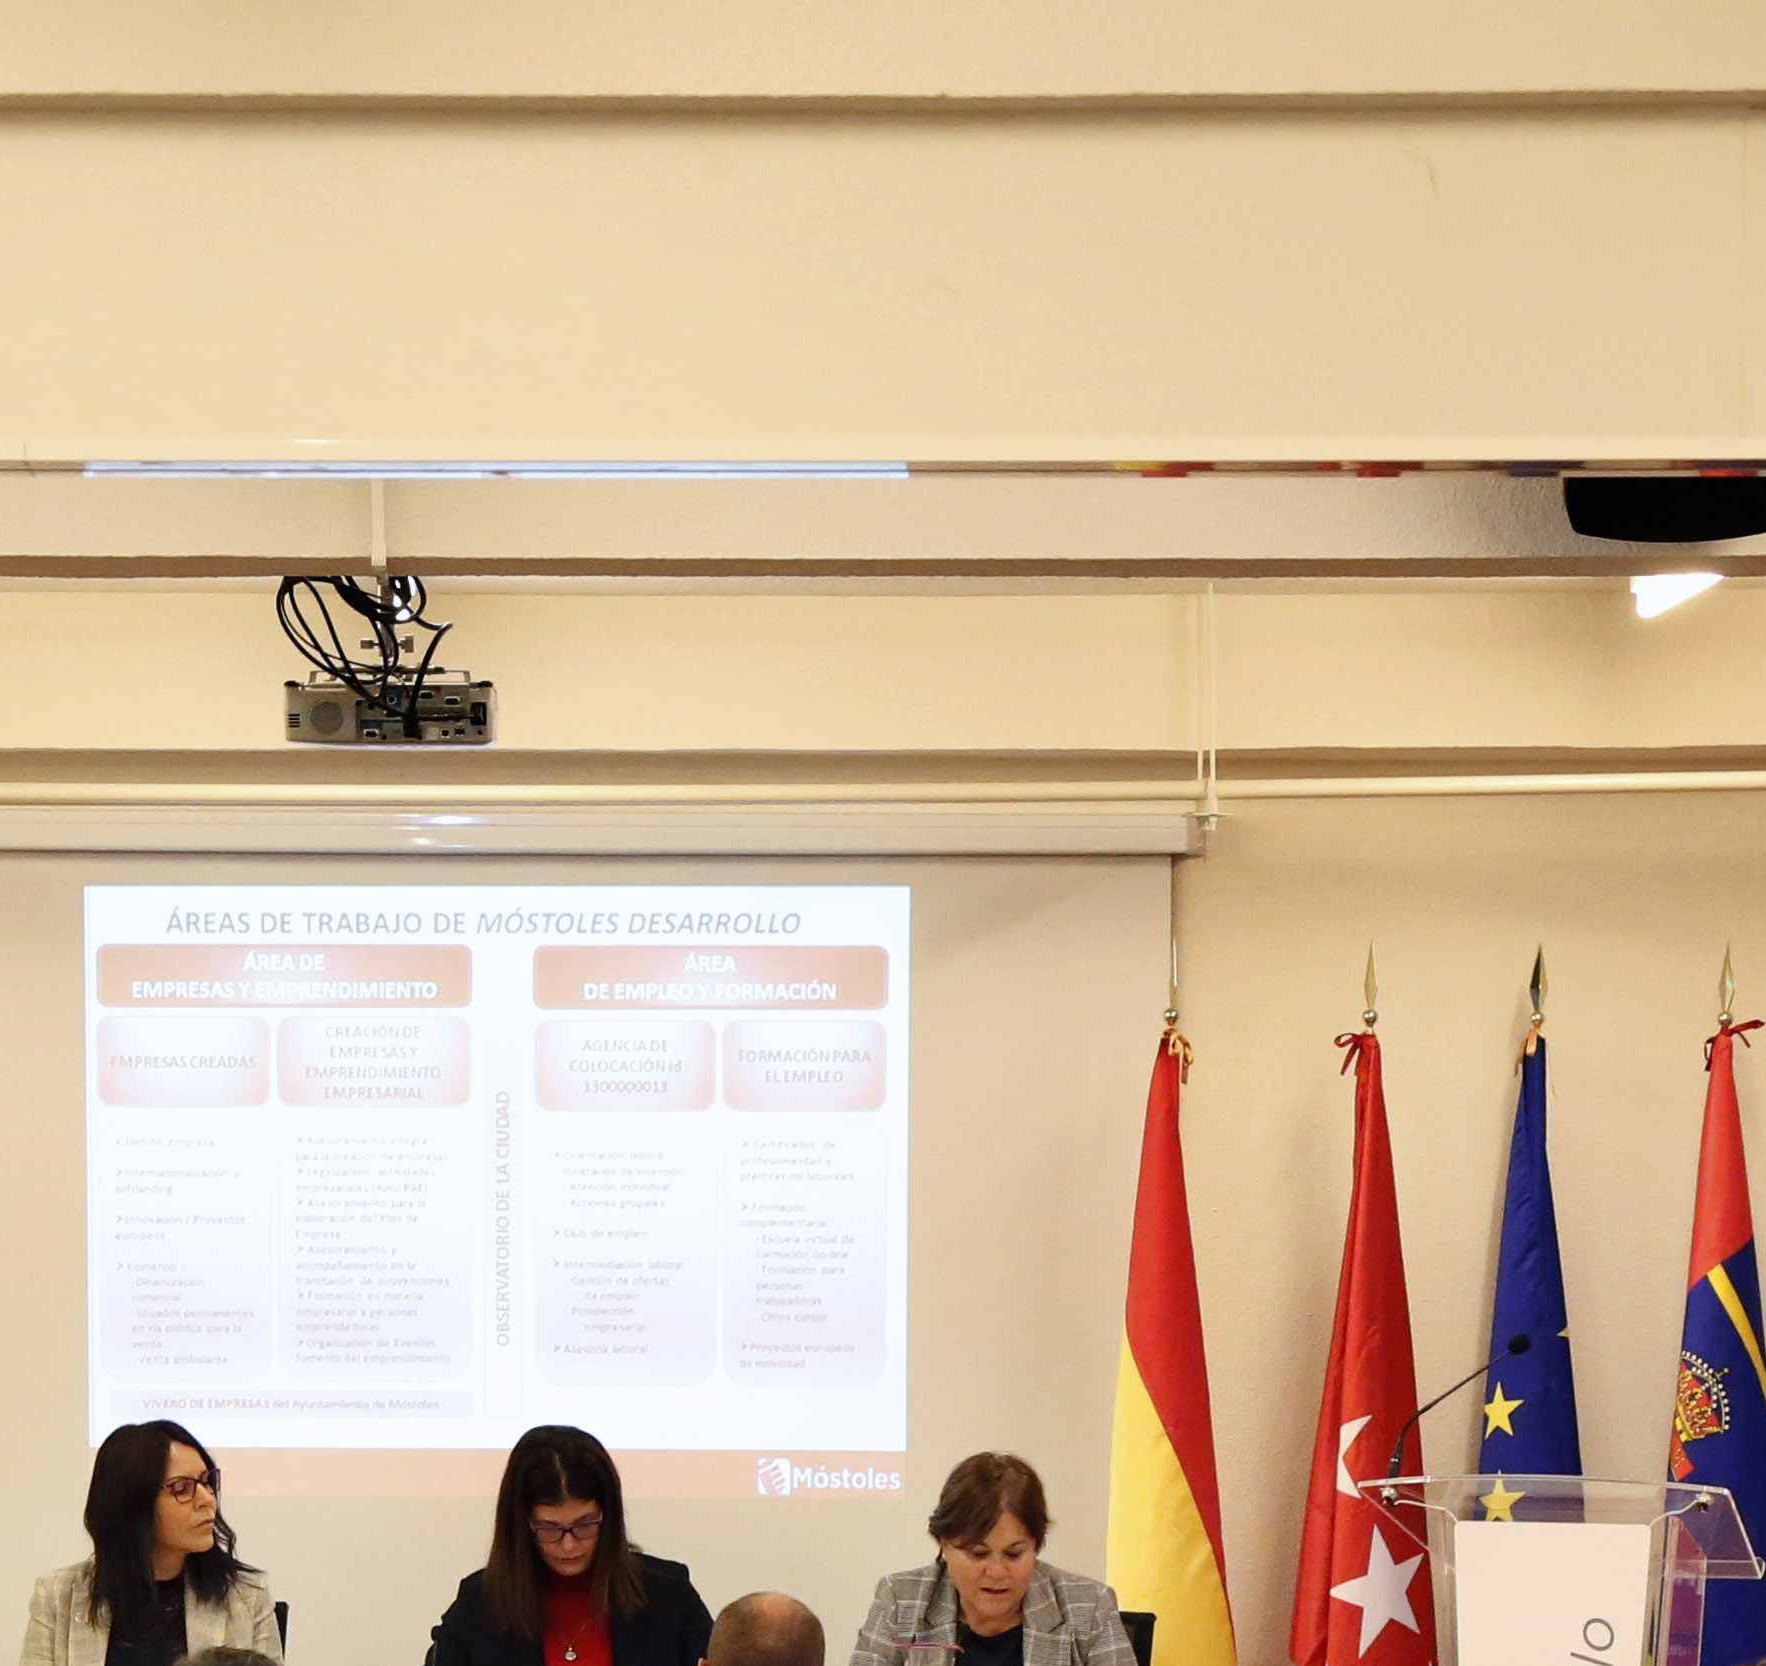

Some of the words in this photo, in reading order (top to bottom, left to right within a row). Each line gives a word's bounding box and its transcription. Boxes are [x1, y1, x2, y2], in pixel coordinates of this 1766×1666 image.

[166, 907, 251, 934] ÁREAS
[261, 913, 292, 934] DE
[303, 913, 422, 934] TRABAJO
[434, 913, 466, 934] DE
[477, 907, 619, 934] MÓSTOLES
[628, 913, 801, 934] DESARROLLO
[243, 951, 294, 972] ÁREA
[298, 955, 325, 972] DE
[684, 953, 736, 973] ÁREA
[132, 982, 235, 1000] EMPRESAS
[238, 982, 252, 1000] Y
[255, 981, 438, 1000] EMPRENDIMIENTO
[583, 983, 609, 1000] DE
[614, 983, 694, 1000] EMPLEO
[698, 983, 712, 1000] Y
[716, 980, 836, 1000] FORMACIÓN
[325, 1024, 400, 1038] CREACIÓN
[402, 1026, 420, 1038] DE
[329, 1046, 408, 1058] EMPRESAS
[409, 1046, 417, 1058] Y
[582, 1040, 647, 1052] AGENCIA
[650, 1040, 668, 1052] DE
[110, 1056, 188, 1069] EMPRESAS
[190, 1056, 256, 1069] CREADAS
[738, 1048, 830, 1063] FORMACIÓN
[833, 1050, 871, 1063] PARA
[305, 1066, 441, 1079] EMPRENDIMIENTO
[569, 1057, 665, 1073] COLOCACIÓN
[765, 1070, 780, 1083] EL
[784, 1070, 843, 1084] EMPLEO
[324, 1087, 425, 1100] EMPRESARIAL
[496, 1091, 510, 1159] CIUDAD
[496, 1163, 510, 1184] LA
[496, 1188, 510, 1210] DE
[496, 1215, 510, 1346] OBSERVATORIO
[189, 1398, 205, 1410] DE
[207, 1398, 270, 1410] EMPRESAS
[793, 1465, 901, 1491] Móstoles
